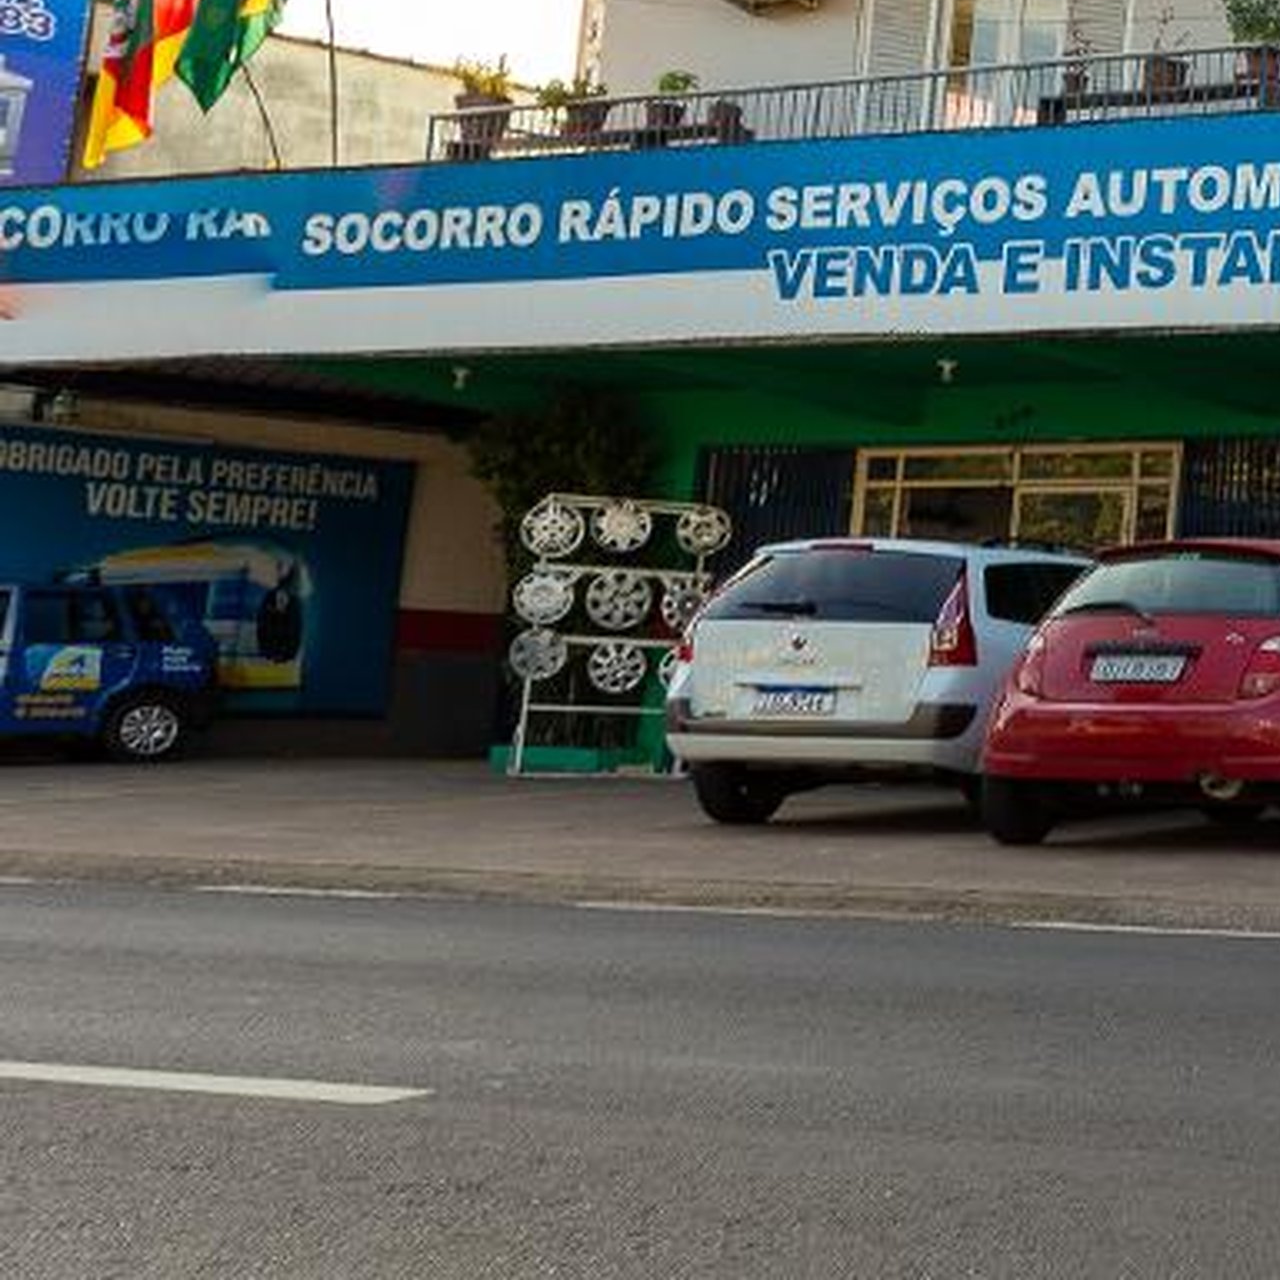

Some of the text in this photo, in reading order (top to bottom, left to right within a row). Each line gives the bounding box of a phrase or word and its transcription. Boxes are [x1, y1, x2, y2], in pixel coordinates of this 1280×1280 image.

[302, 202, 542, 255] SOCORRO
[558, 187, 755, 243] RÁPIDO
[766, 174, 1048, 236] SERVIÇOS
[769, 242, 980, 300] VENDA
[1002, 239, 1044, 294] E
[136, 452, 204, 486] PELA
[210, 459, 379, 502] PREFERÊNCIA
[86, 481, 319, 532] VOLTE SEMPRE!
